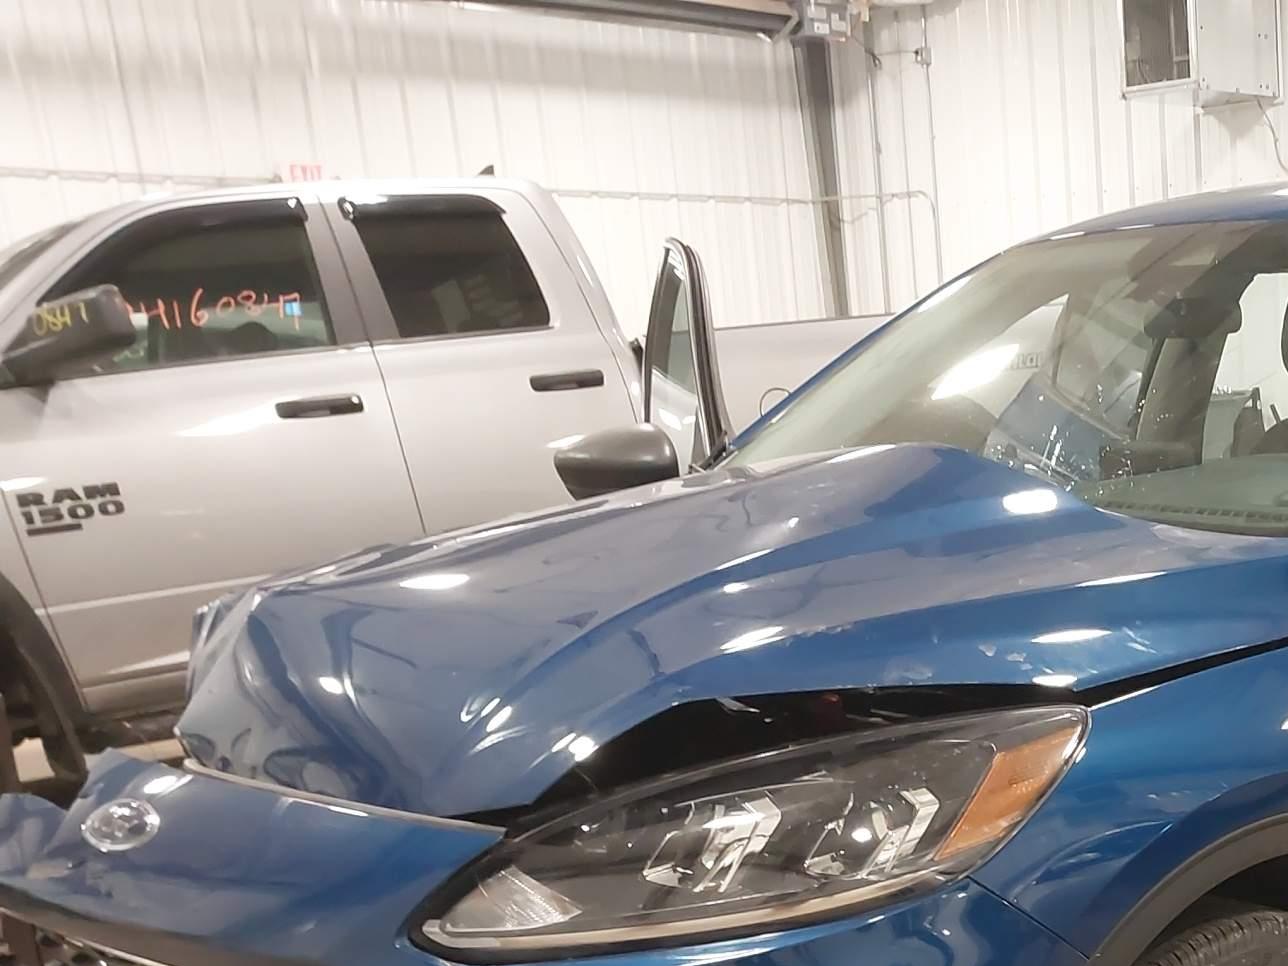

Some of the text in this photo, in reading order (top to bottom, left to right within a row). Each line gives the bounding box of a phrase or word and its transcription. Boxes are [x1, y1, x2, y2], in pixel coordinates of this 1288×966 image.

[289, 164, 322, 182] EXIT
[16, 481, 121, 508] RAM
[21, 499, 125, 525] 1500
